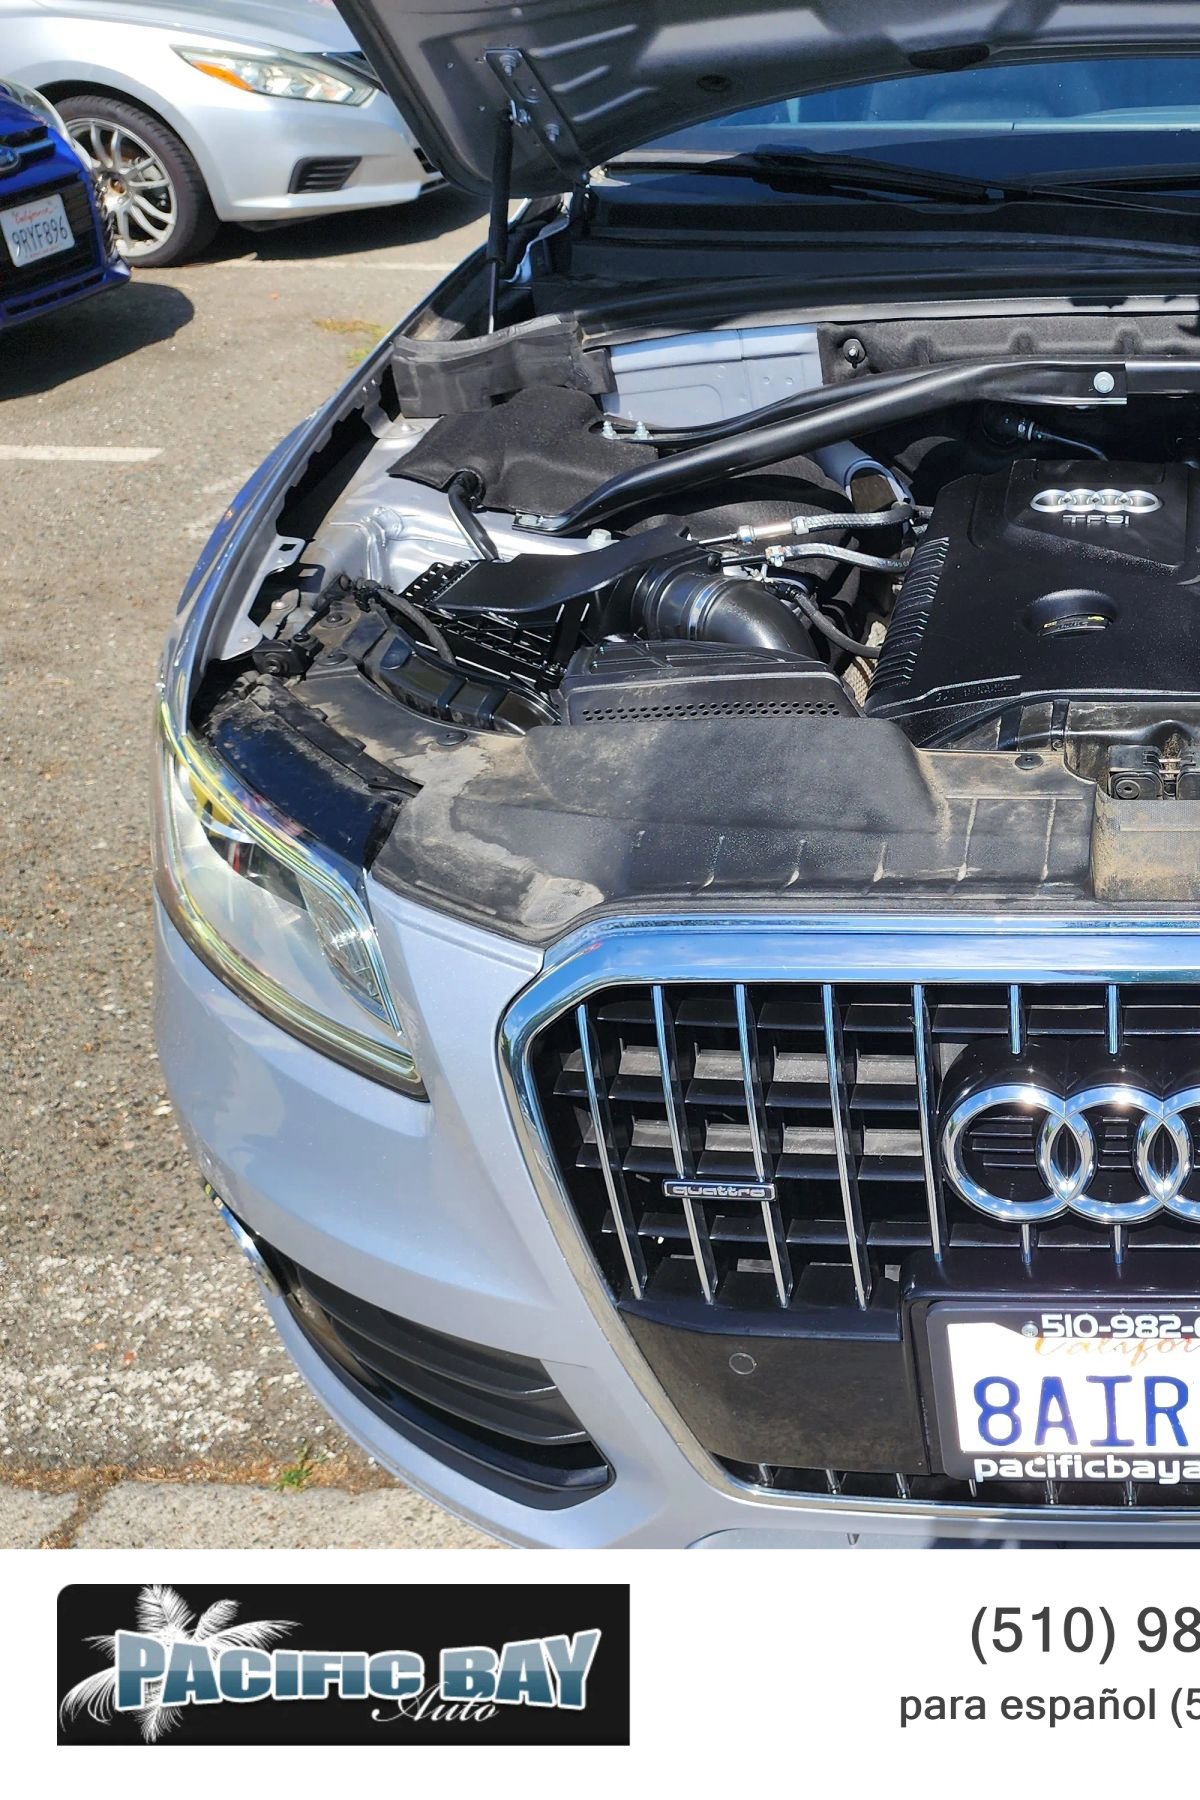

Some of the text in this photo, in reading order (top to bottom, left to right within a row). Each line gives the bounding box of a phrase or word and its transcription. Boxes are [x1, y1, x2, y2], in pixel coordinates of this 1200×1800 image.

[12, 215, 68, 257] 9RYF896
[1062, 514, 1130, 525] TFSI
[672, 1186, 766, 1198] quattro
